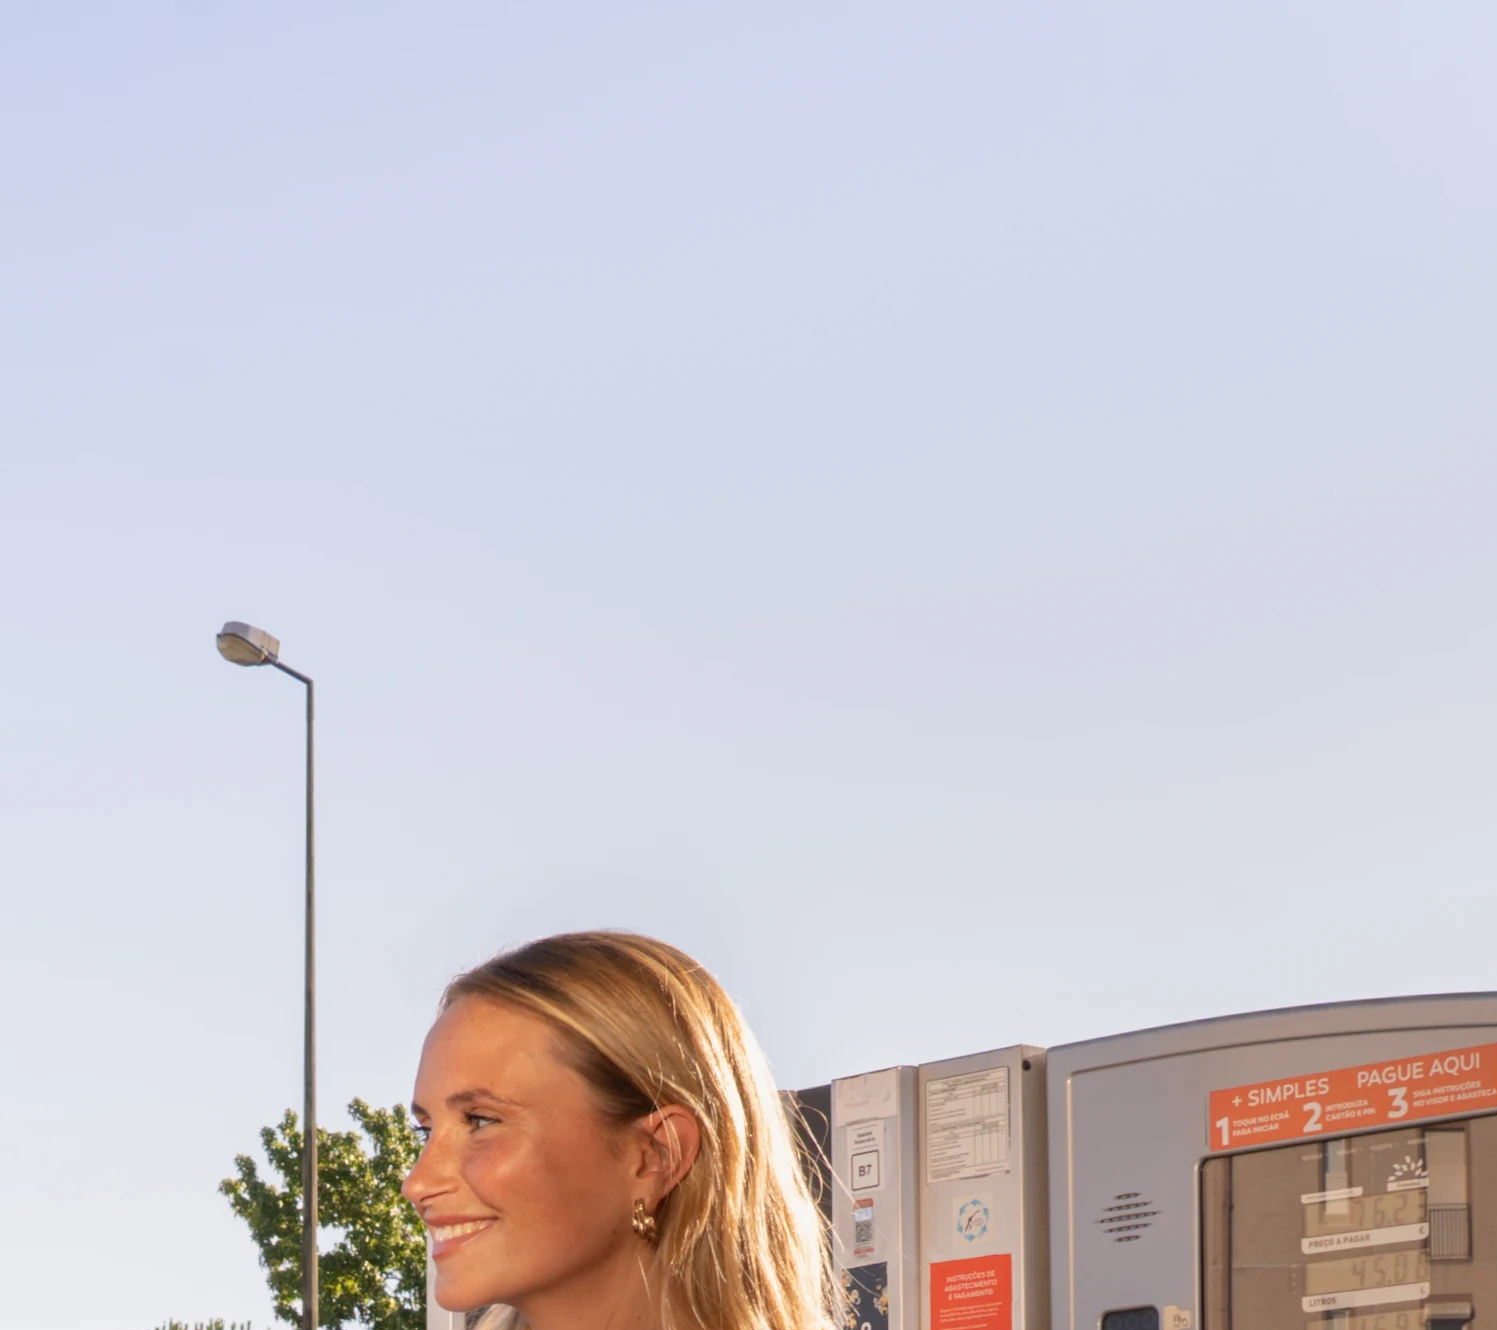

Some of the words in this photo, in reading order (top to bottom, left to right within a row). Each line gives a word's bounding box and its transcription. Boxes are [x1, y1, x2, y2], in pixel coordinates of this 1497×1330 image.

[1248, 1078, 1329, 1107] SIMPLES
[1358, 1062, 1424, 1088] PAGUE
[1429, 1052, 1480, 1077] AQUI
[1413, 1088, 1431, 1098] SIGA
[1432, 1080, 1481, 1096] INSTRUÇÕES
[1325, 1099, 1368, 1112] INTRODUZA
[1387, 1087, 1407, 1118] 3
[1413, 1099, 1424, 1108] NO
[1425, 1095, 1449, 1106] VISOR
[1456, 1088, 1497, 1102] ABASTEÇA
[1233, 1117, 1255, 1128] TOQUE
[1257, 1115, 1269, 1125] NO
[1303, 1102, 1322, 1132] 2
[1326, 1110, 1355, 1122] CARTÃO
[1363, 1107, 1375, 1117] PIN
[1216, 1117, 1229, 1145] 1
[1233, 1127, 1251, 1137] PARA
[1252, 1123, 1279, 1134] INICIAR
[858, 1164, 872, 1177] B7
[1308, 1237, 1334, 1249] PREÇO
[1336, 1236, 1342, 1244] A
[1343, 1233, 1370, 1243] PAGAR
[1309, 1297, 1336, 1307] LITROS
